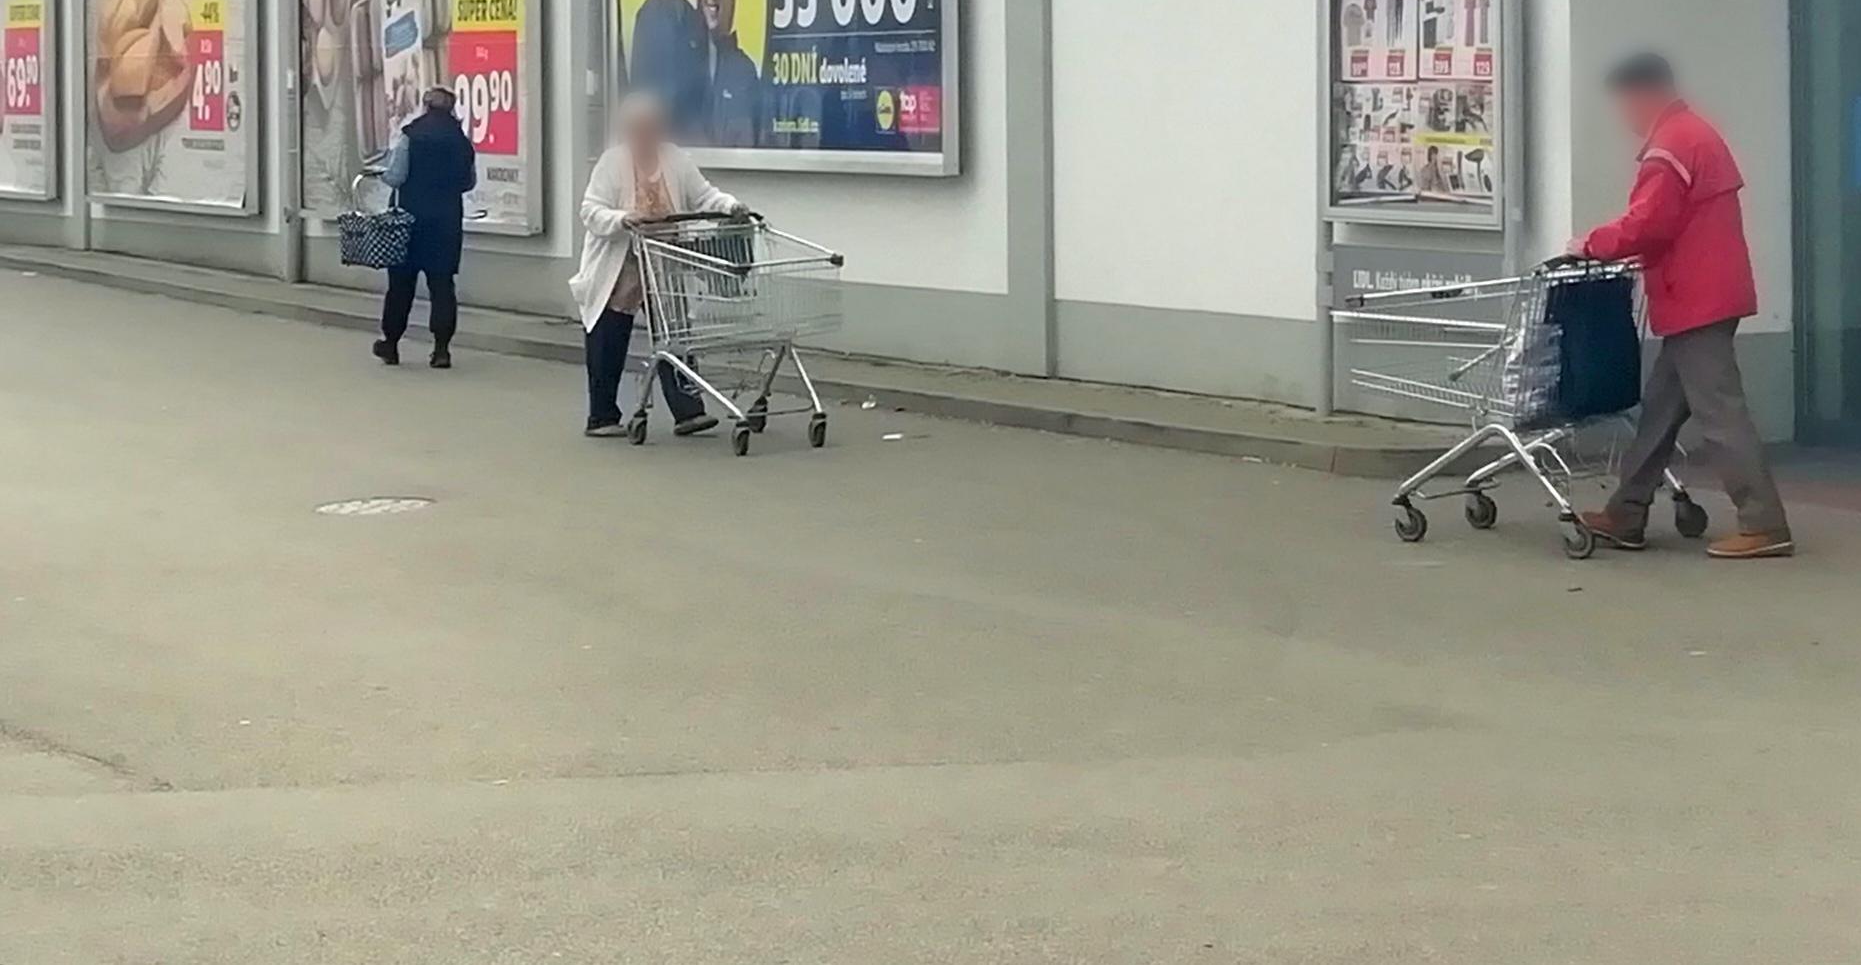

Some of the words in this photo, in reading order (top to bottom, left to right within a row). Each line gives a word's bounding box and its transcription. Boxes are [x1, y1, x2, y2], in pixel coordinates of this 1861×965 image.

[772, 52, 790, 84] 30
[791, 45, 818, 84] DNÍ
[819, 57, 867, 83] dovolené
